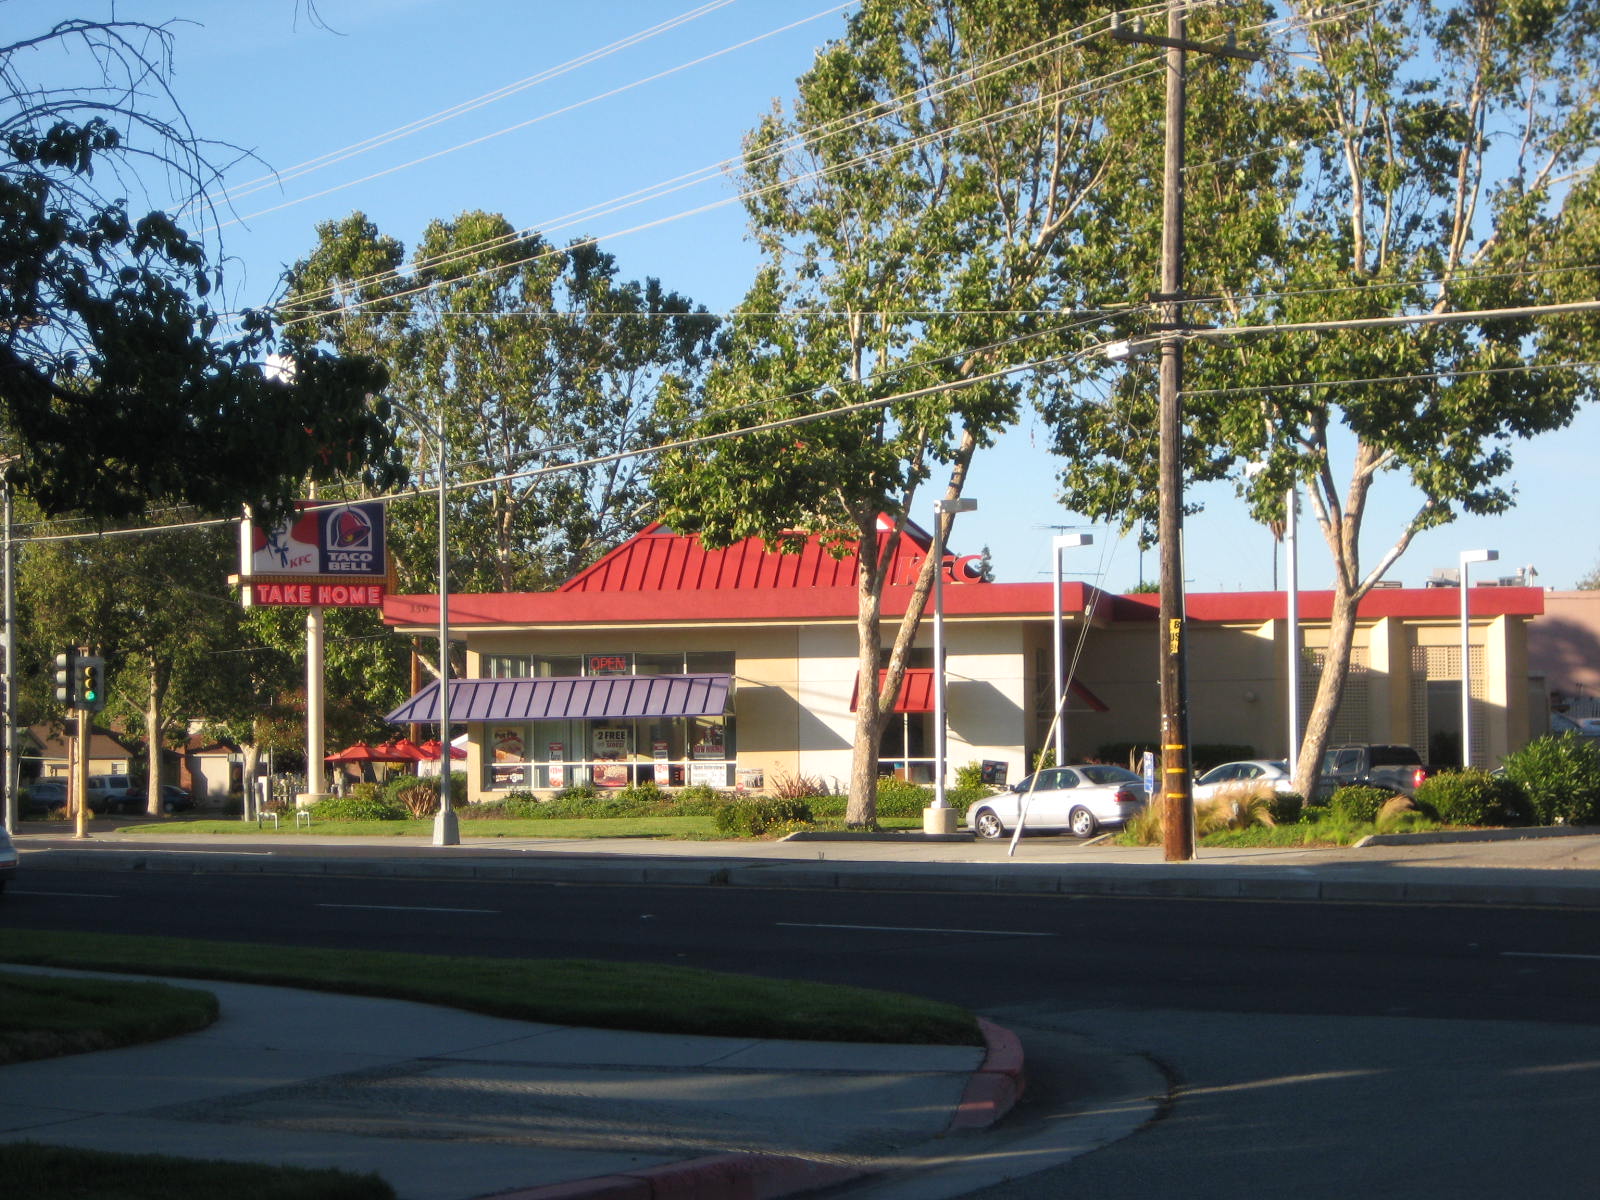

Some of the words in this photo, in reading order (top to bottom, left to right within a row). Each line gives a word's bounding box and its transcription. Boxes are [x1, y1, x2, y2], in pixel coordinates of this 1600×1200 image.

[290, 554, 312, 568] KFC
[327, 552, 373, 561] TACO
[328, 562, 371, 571] BELL
[257, 584, 312, 603] TAKE
[318, 585, 380, 604] HOME
[590, 656, 625, 671] OPEN
[598, 731, 604, 740] 2
[605, 731, 626, 740] FREE
